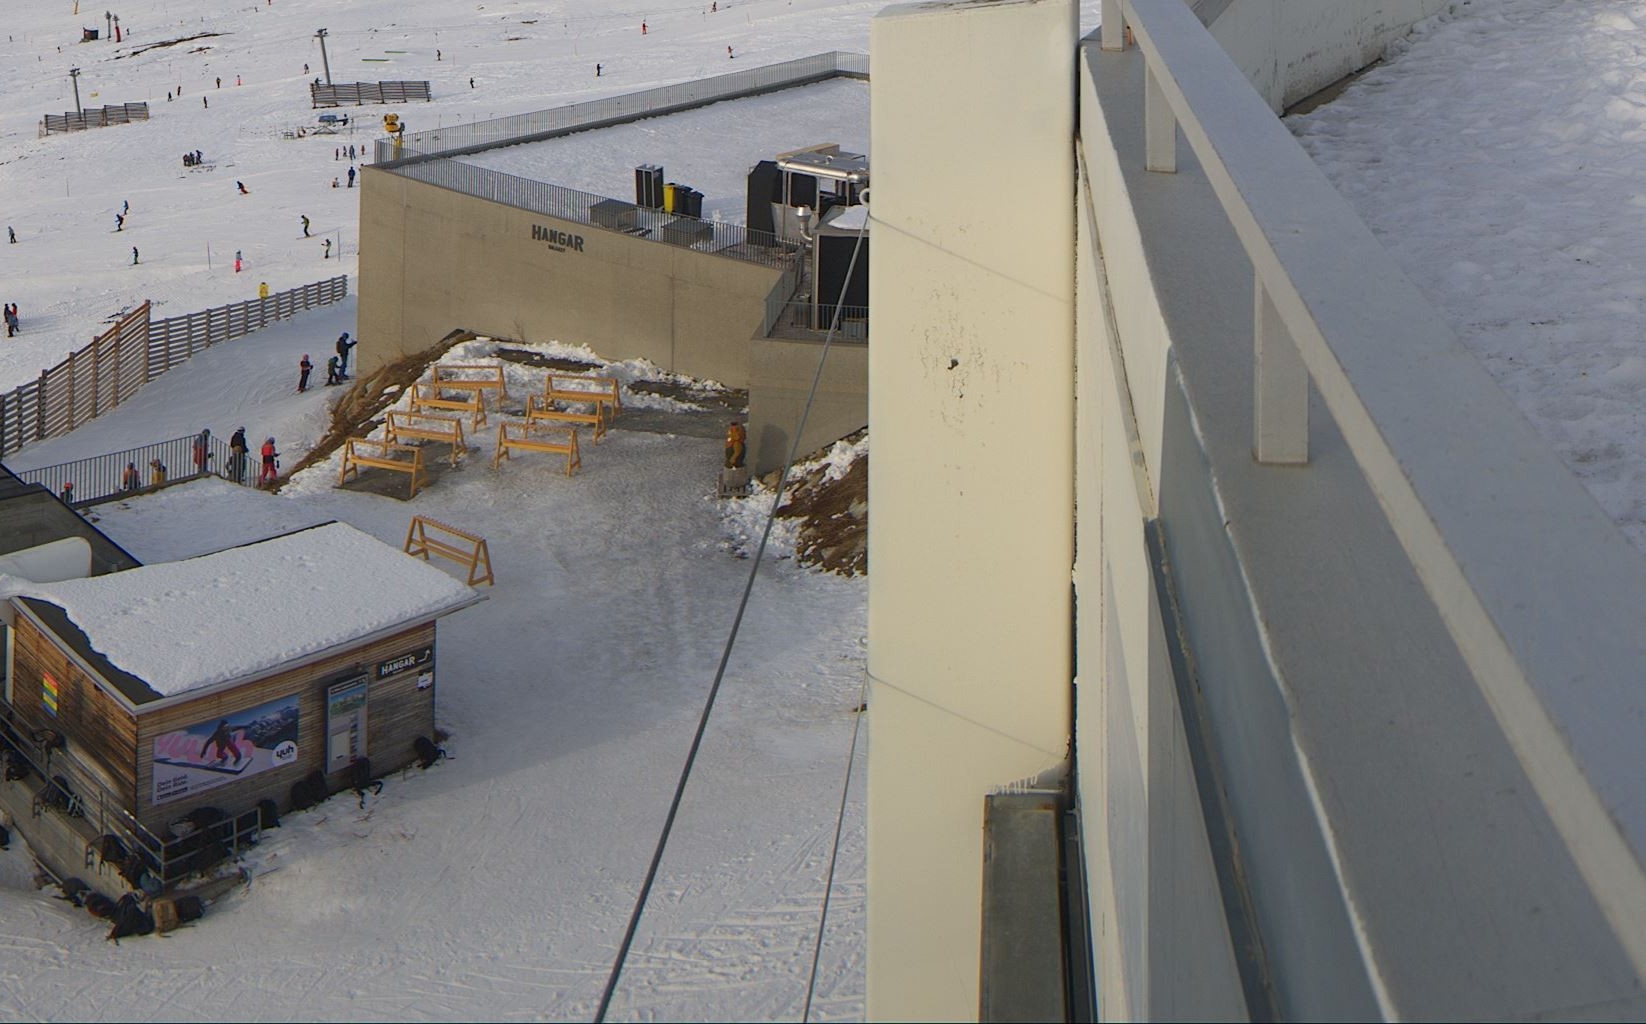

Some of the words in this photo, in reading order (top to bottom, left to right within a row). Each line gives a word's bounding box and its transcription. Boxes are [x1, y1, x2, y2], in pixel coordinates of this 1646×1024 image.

[531, 224, 584, 252] HANGAR
[381, 655, 417, 675] HANGAR
[276, 745, 294, 759] yuh
